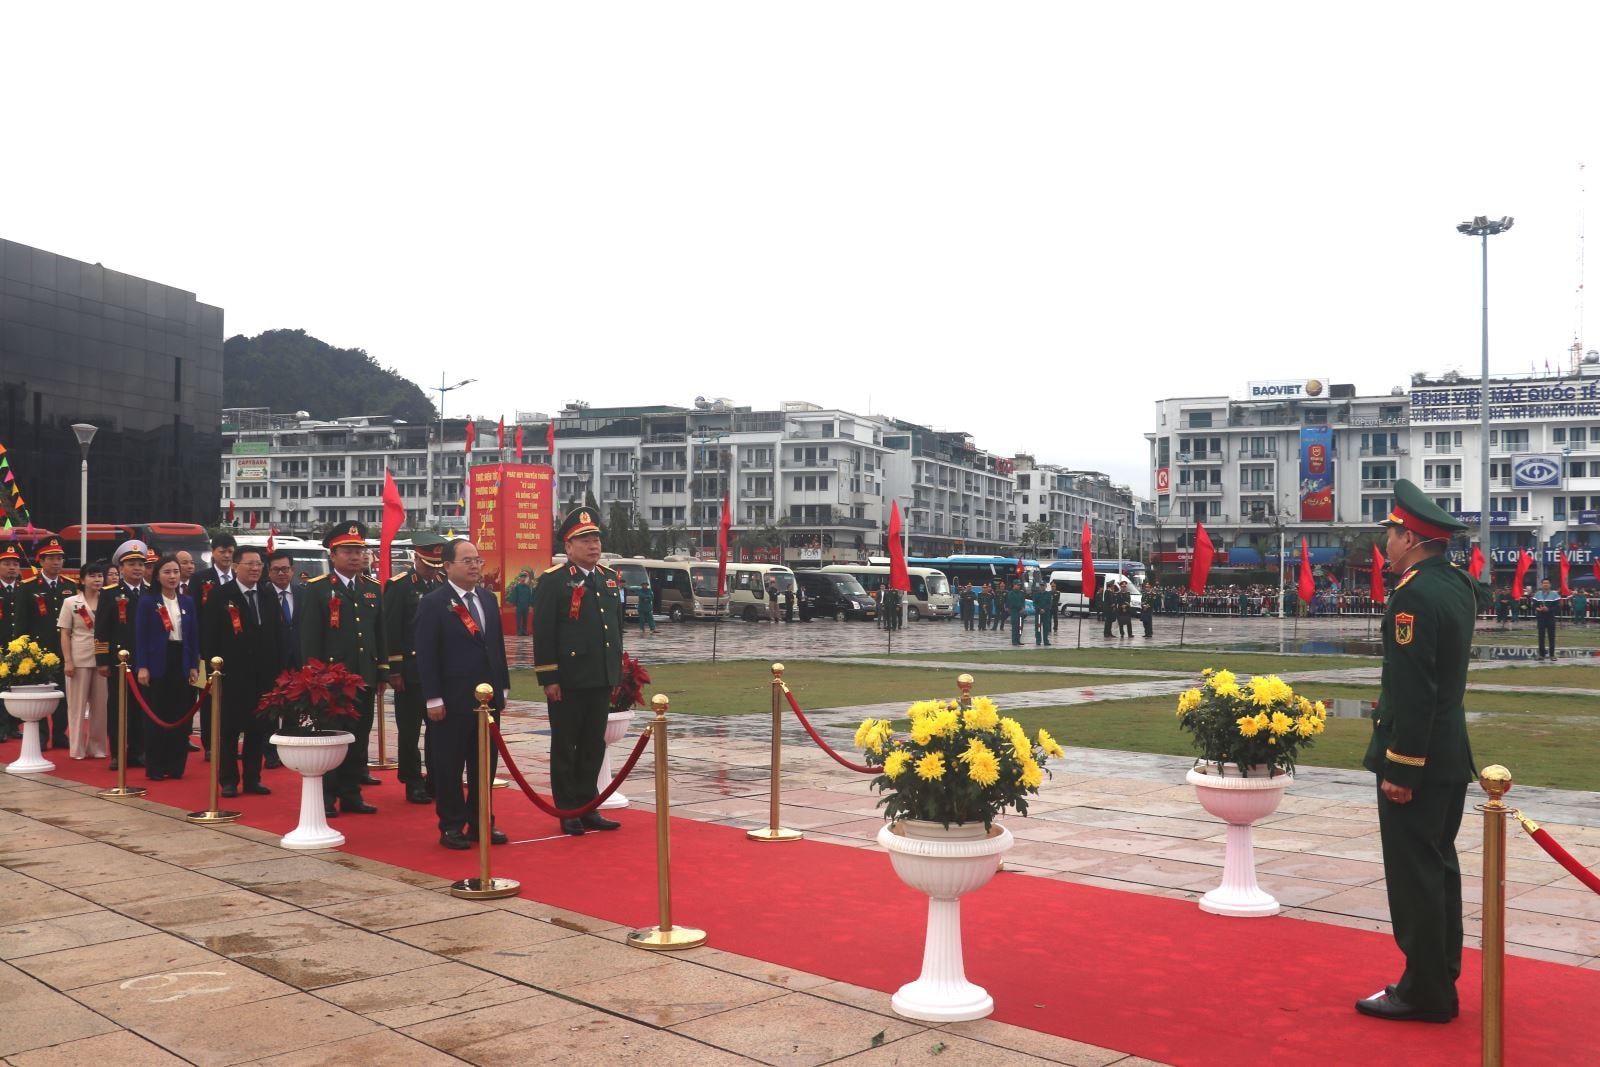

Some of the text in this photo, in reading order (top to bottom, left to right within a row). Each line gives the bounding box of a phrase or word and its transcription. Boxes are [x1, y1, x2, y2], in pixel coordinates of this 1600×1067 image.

[1252, 385, 1302, 396] BAOVIET
[1509, 404, 1599, 419] INTERNATIONAL
[1566, 548, 1592, 565] VIỆT
